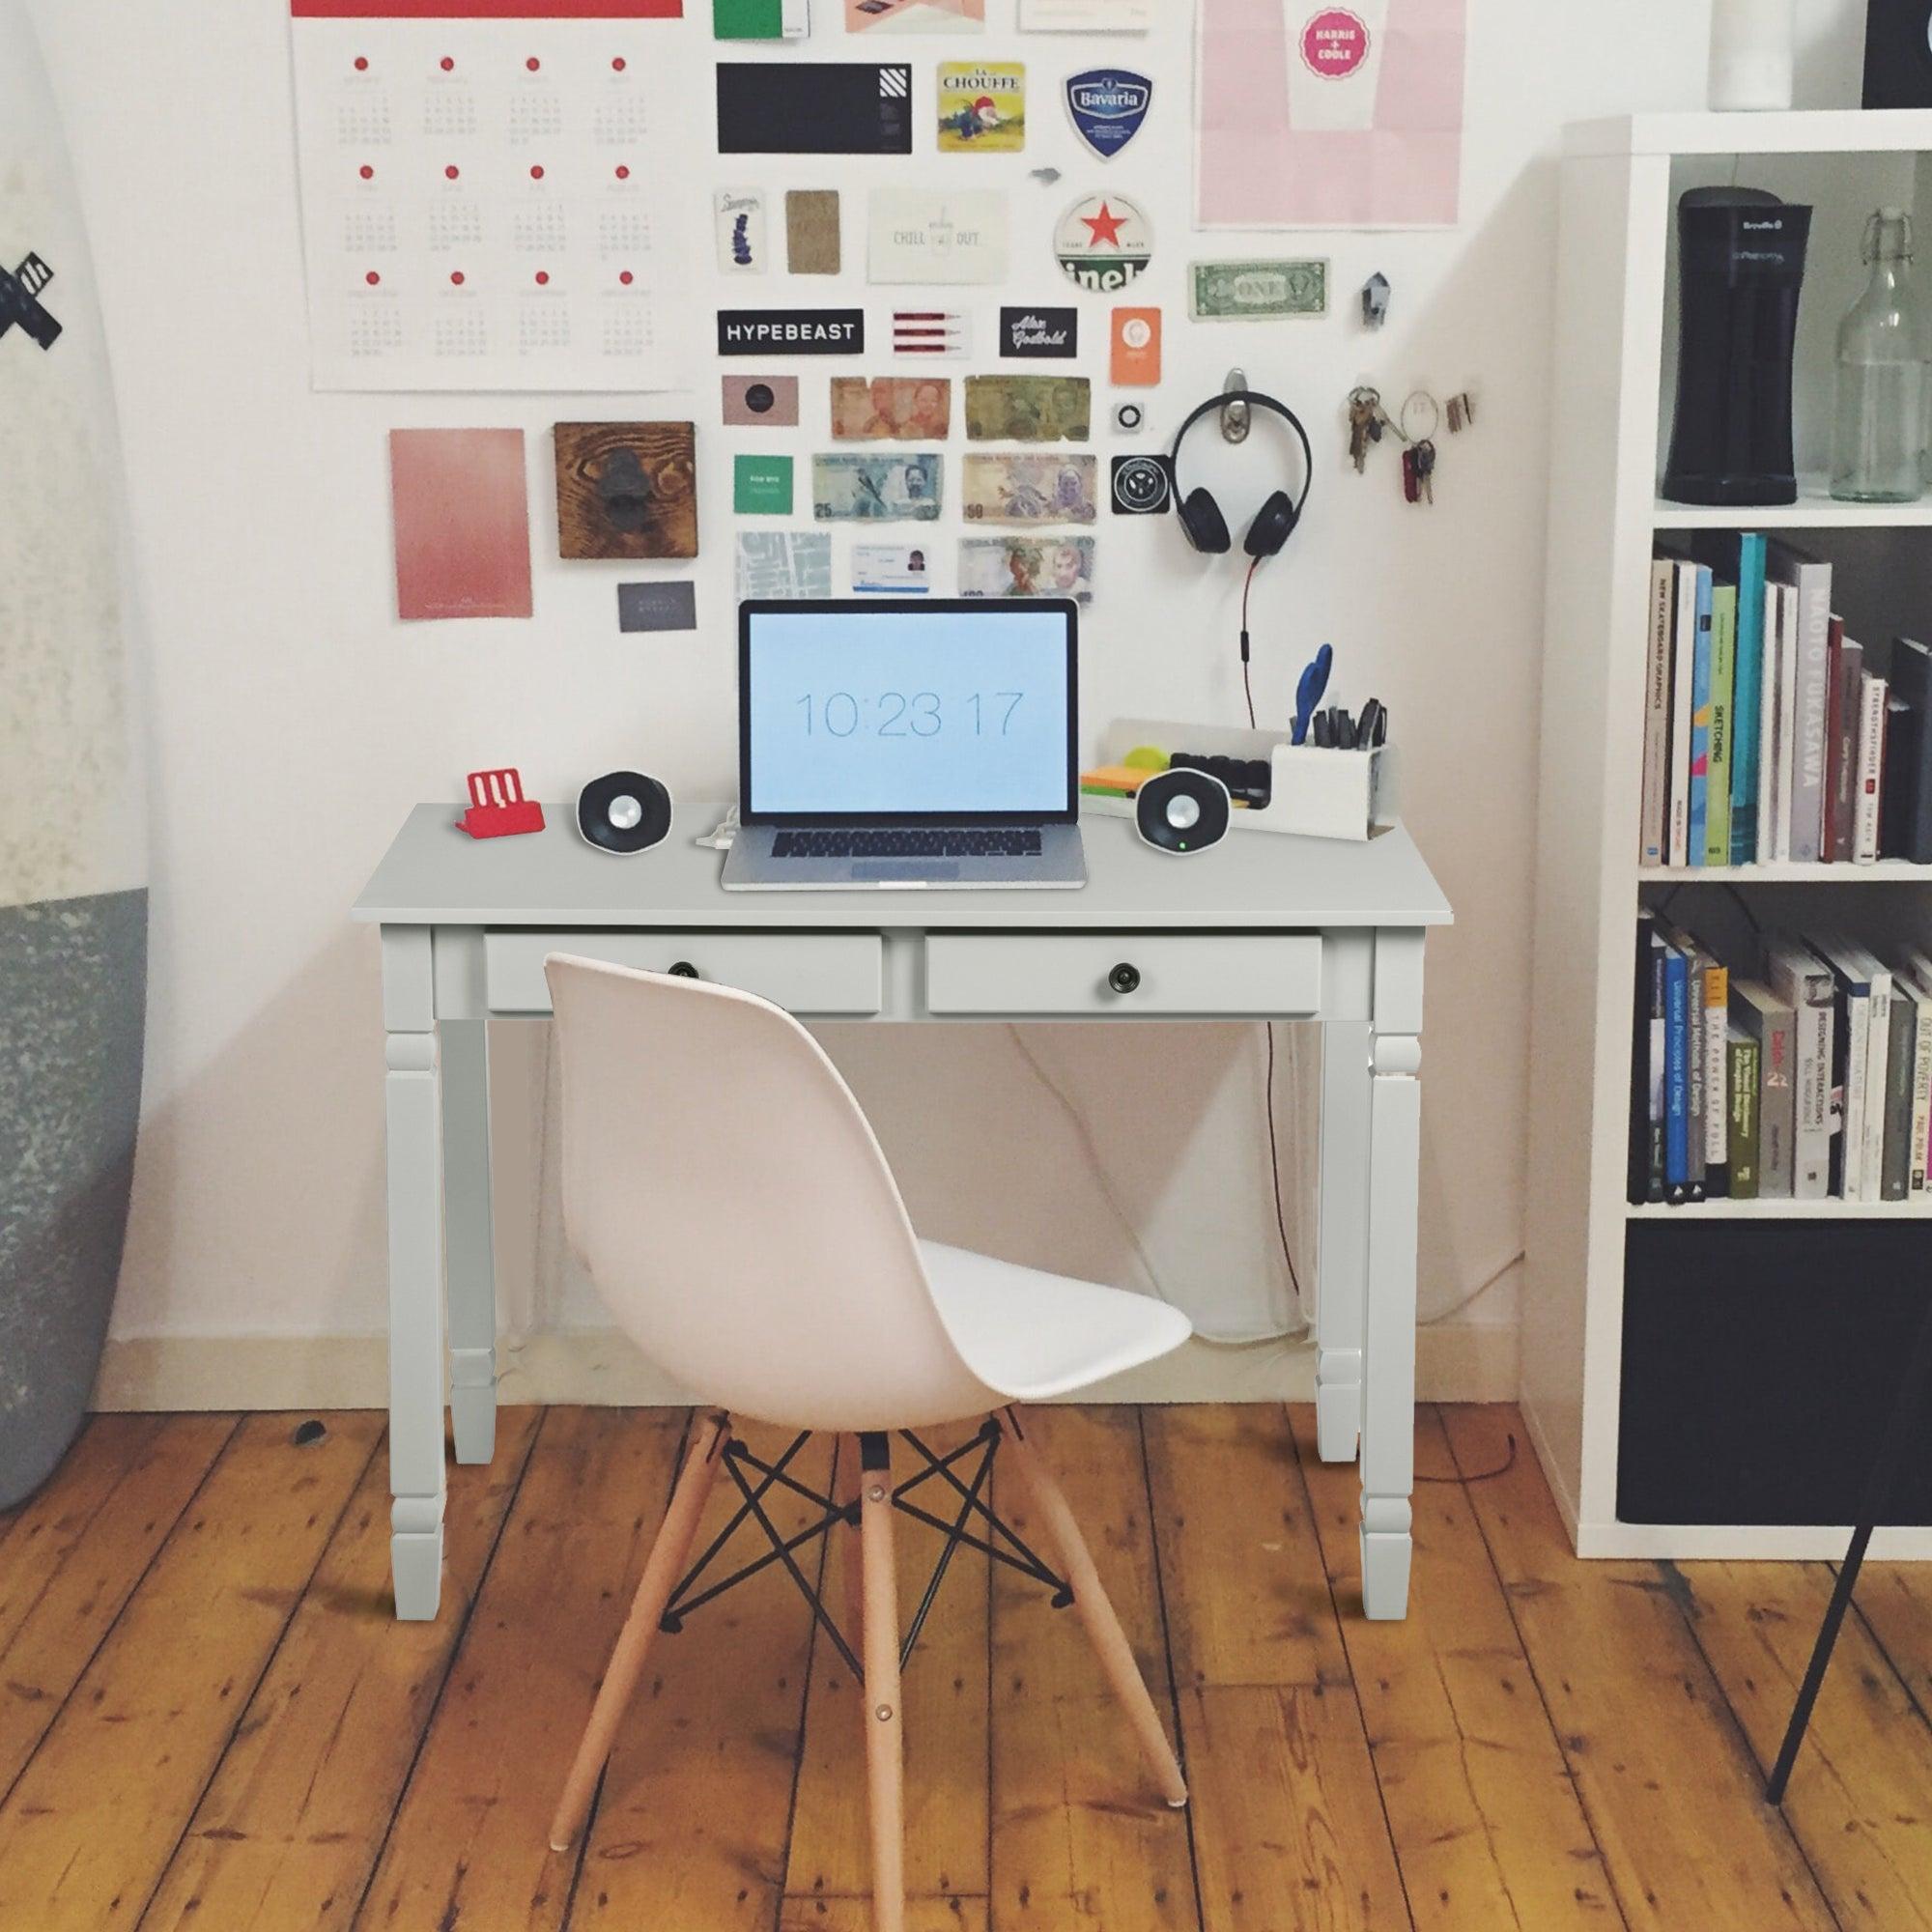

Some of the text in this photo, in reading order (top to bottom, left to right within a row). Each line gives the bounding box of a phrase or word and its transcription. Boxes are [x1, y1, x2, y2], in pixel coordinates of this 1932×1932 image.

[1316, 30, 1355, 41] HARRIS
[943, 77, 1019, 90] CHOUFFE
[1080, 91, 1138, 107] Bavaria
[893, 231, 980, 245] CHILL OUT
[1011, 315, 1046, 330] Alex
[726, 323, 855, 341] HYPEBEAST
[815, 502, 832, 519] 25
[1802, 587, 1829, 788] NAOTO FUKASAWA
[796, 691, 1024, 737] 10:23 17
[1713, 705, 1724, 763] SKETCHING
[1817, 1011, 1827, 1060] DESIGNING
[1767, 1071, 1788, 1088] 22
[1916, 1057, 1930, 1101] POVERTY
